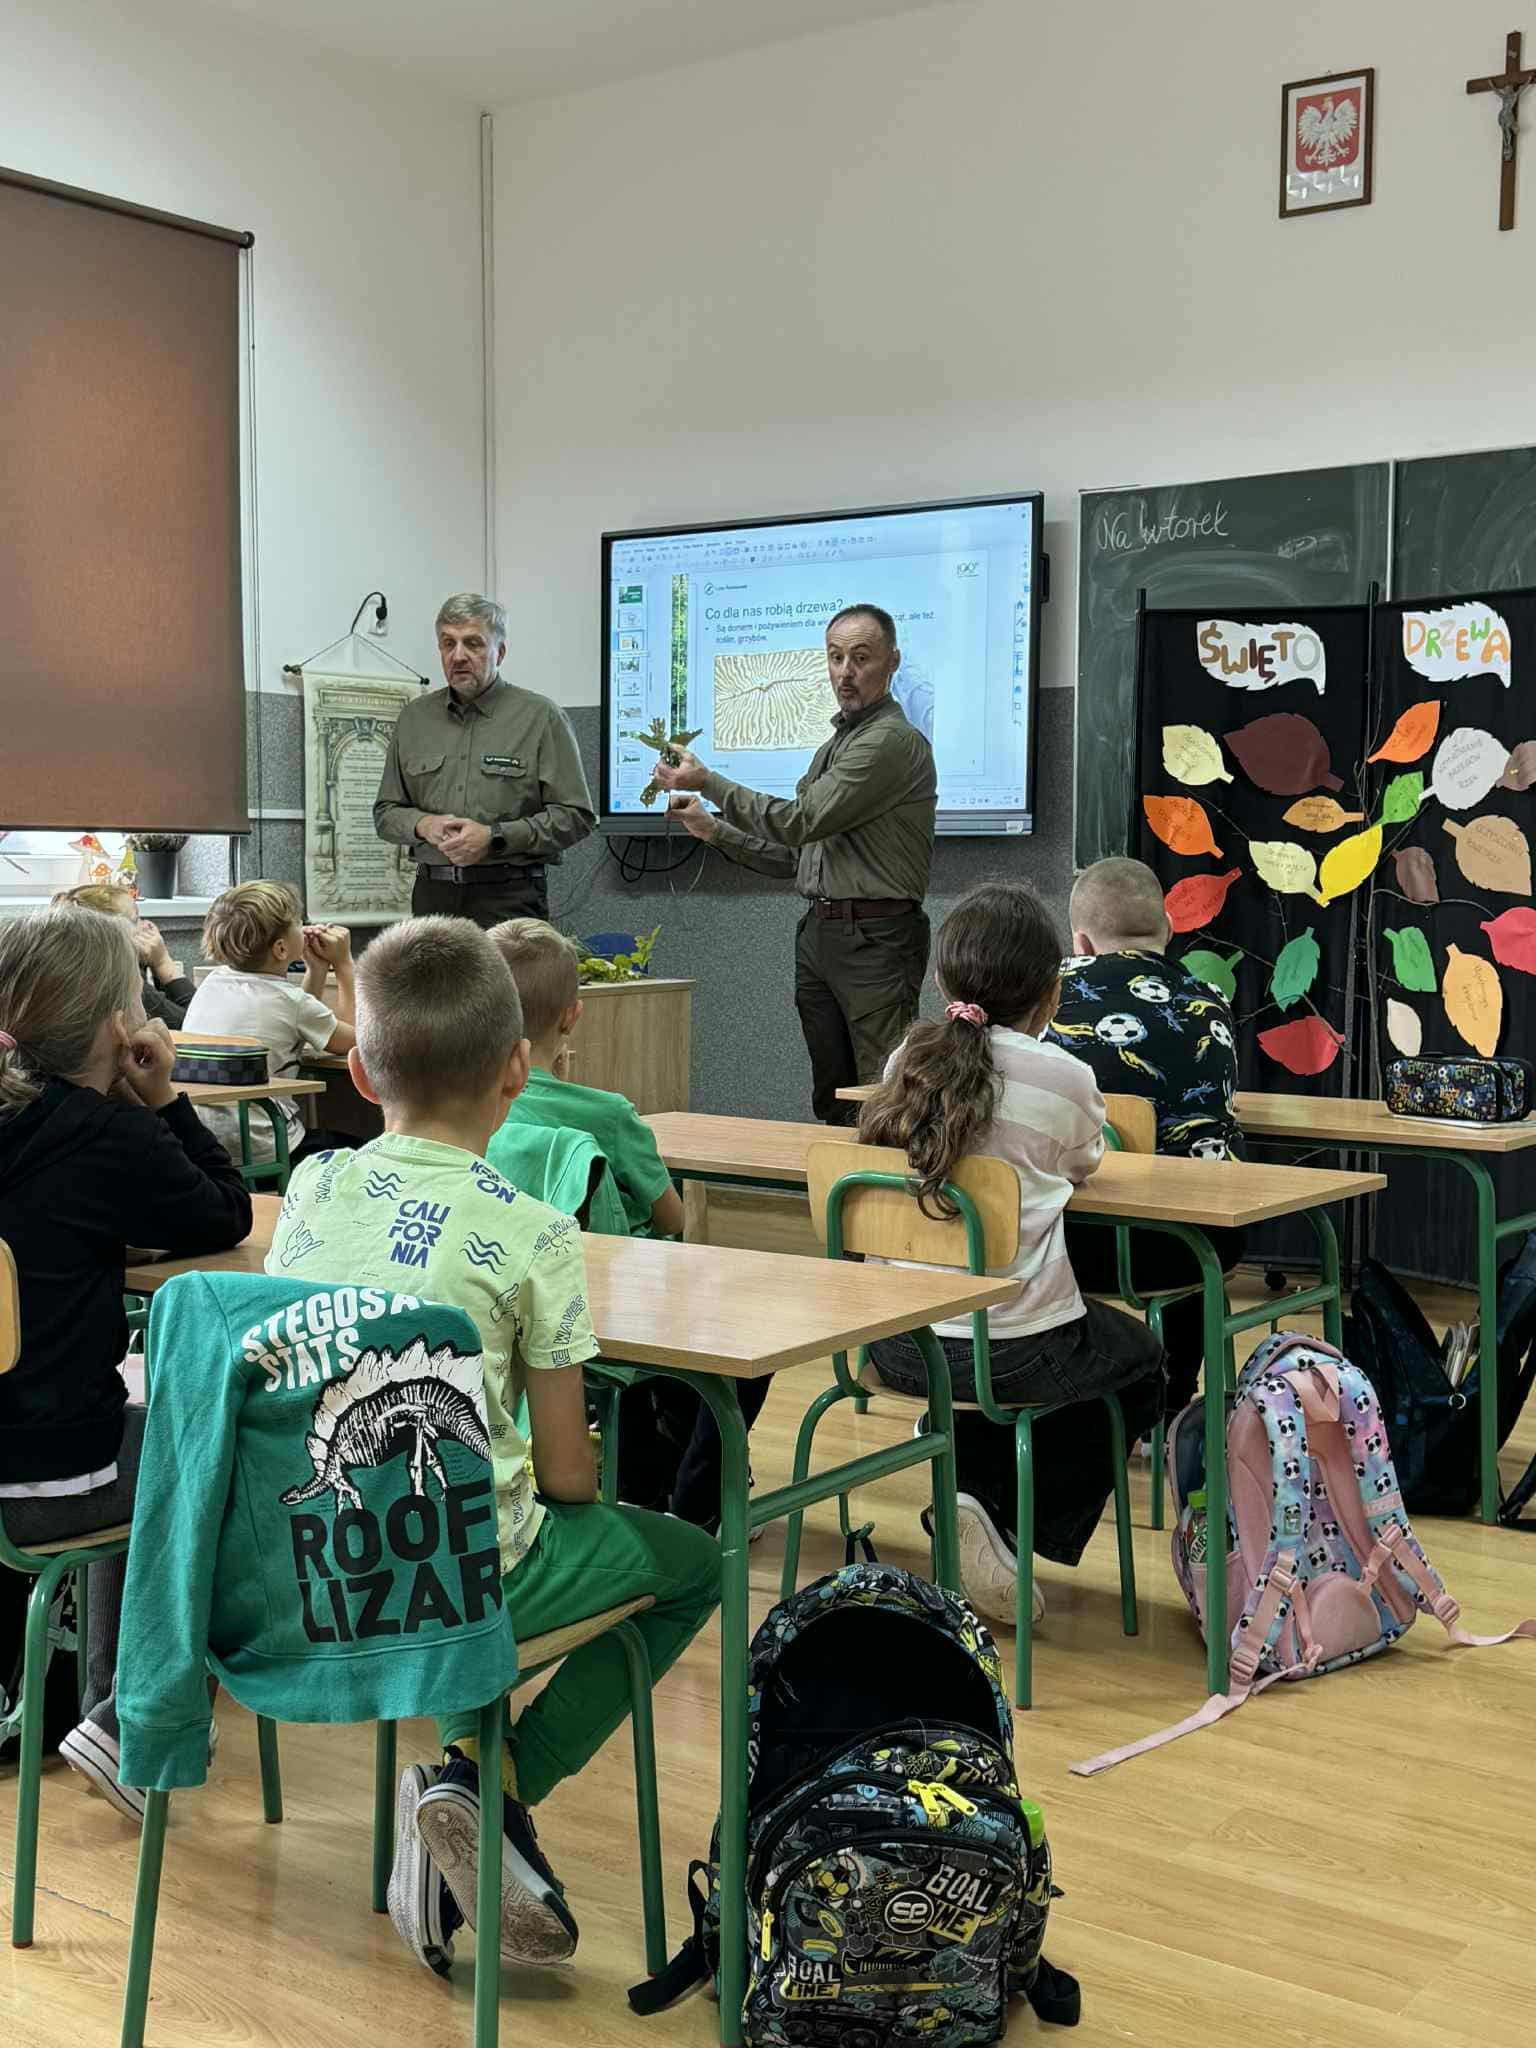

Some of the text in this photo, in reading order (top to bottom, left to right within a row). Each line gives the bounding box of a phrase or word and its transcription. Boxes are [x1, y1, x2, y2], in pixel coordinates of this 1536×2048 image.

[1099, 500, 1230, 551] Na wtorek
[705, 598, 844, 620] Co dla nas robią drzewa?
[1199, 622, 1321, 684] ŚWIĘTO
[1406, 617, 1510, 664] DRZEWA
[399, 1199, 452, 1225] CALI
[476, 1178, 517, 1205] ON
[388, 1218, 442, 1248] FOR
[390, 1241, 429, 1269] NIA
[241, 1286, 434, 1363] STEGOSA
[258, 1326, 363, 1393] STATS
[290, 1480, 493, 1582] ROOF
[925, 1863, 993, 1913] GOAL
[787, 1951, 841, 1984] GOAL
